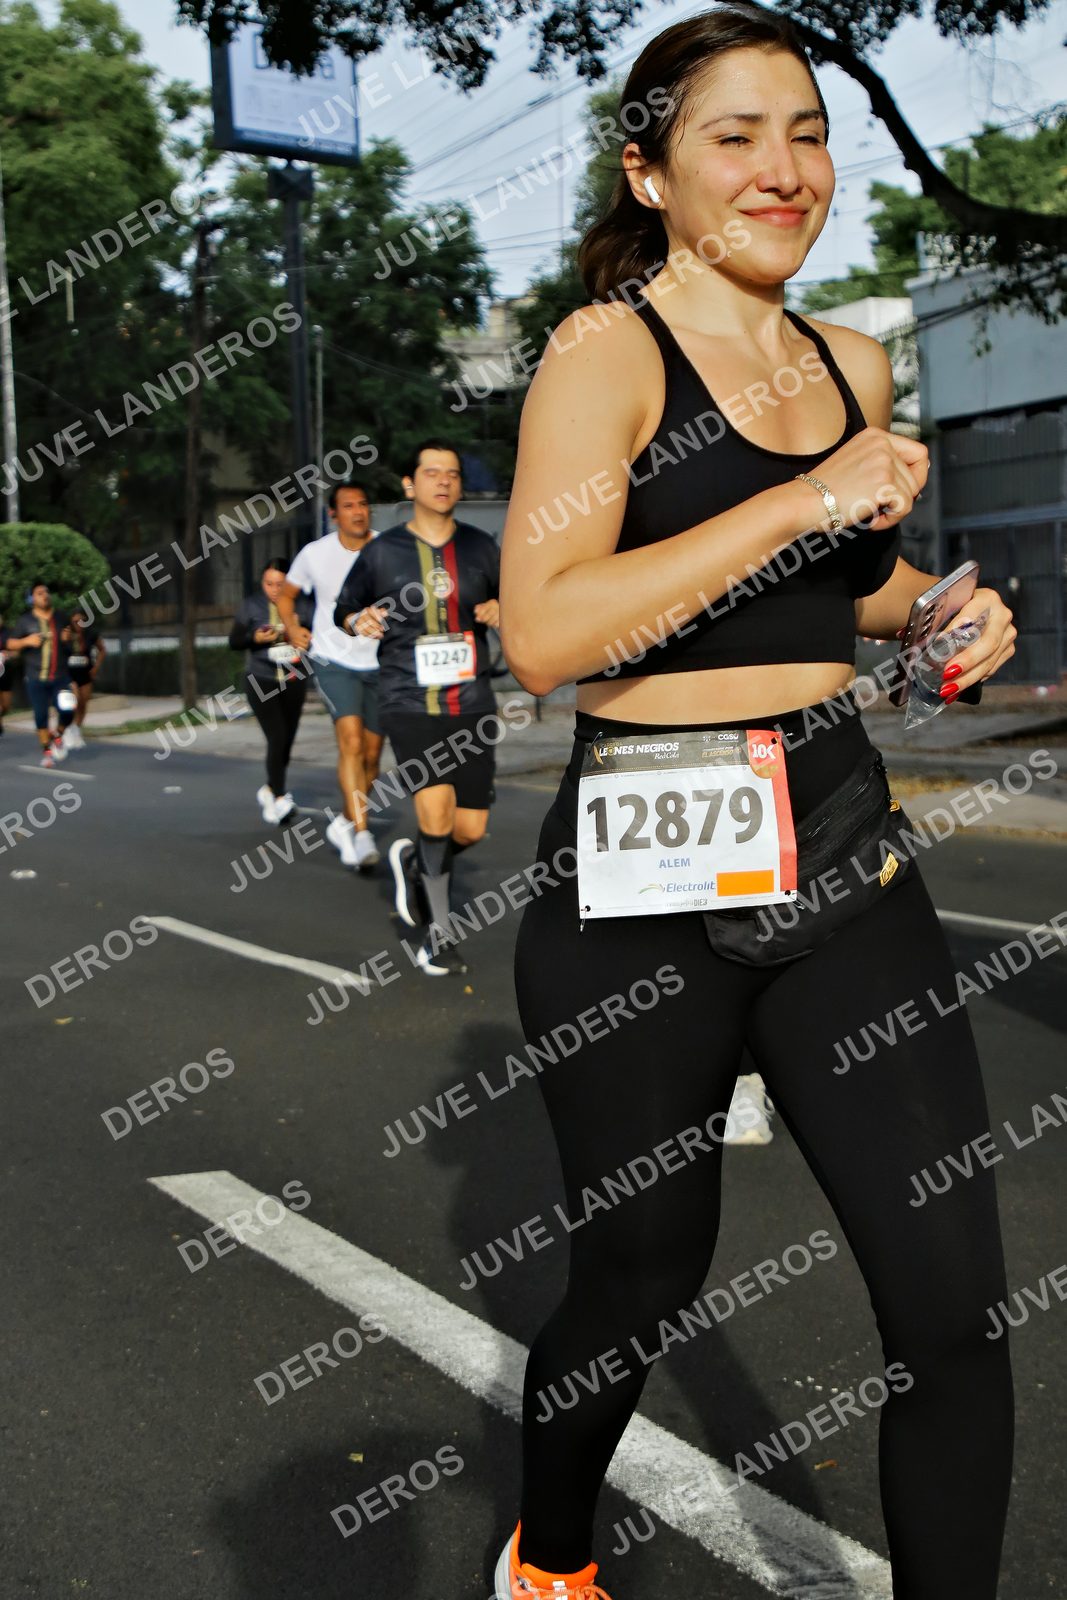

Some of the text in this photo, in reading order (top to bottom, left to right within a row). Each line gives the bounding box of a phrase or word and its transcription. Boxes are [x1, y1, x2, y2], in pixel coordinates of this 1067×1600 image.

[422, 648, 468, 666] 12247
[636, 742, 679, 754] NEGROS
[752, 744, 776, 760] 10K
[587, 786, 763, 852] 12879
[659, 858, 691, 868] ALEM
[666, 881, 716, 892] Electrolit
